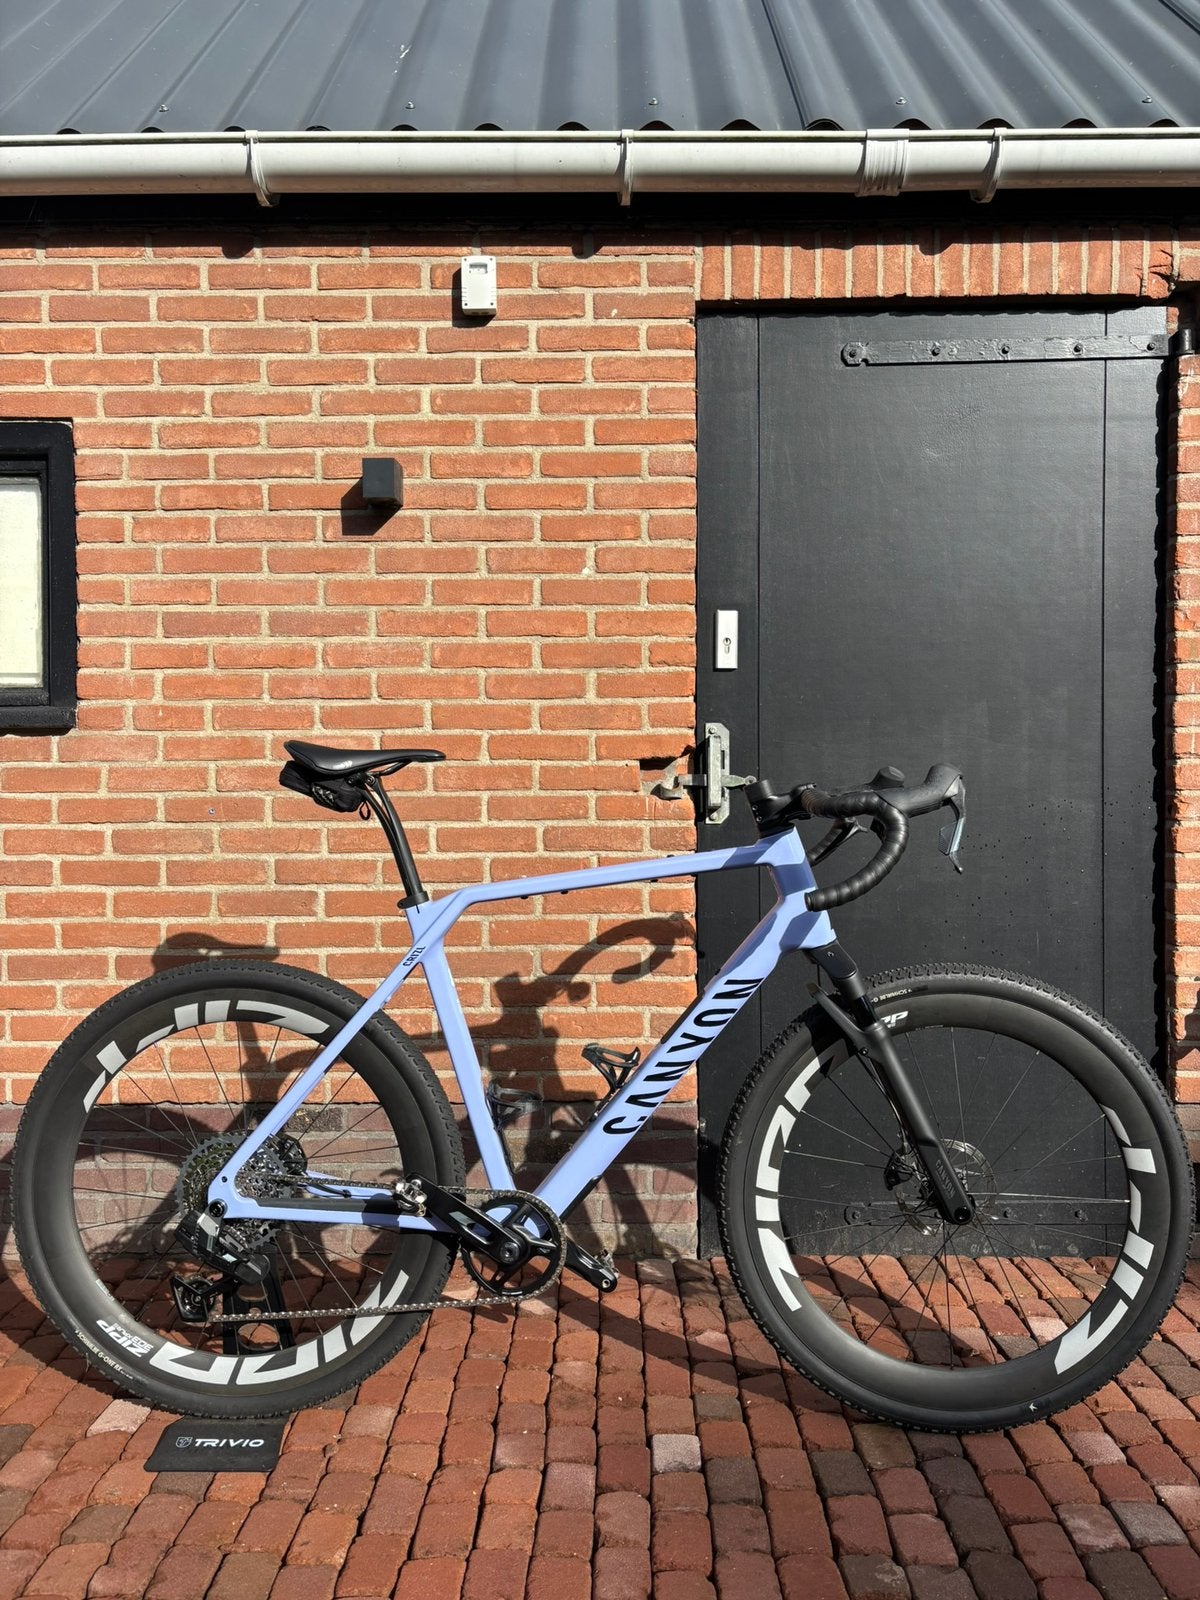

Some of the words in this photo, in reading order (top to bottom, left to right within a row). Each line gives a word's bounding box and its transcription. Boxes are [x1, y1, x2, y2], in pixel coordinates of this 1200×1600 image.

[602, 977, 765, 1135] CANYON
[96, 1319, 150, 1358] ZIPP
[194, 1438, 265, 1448] TRIVIO
